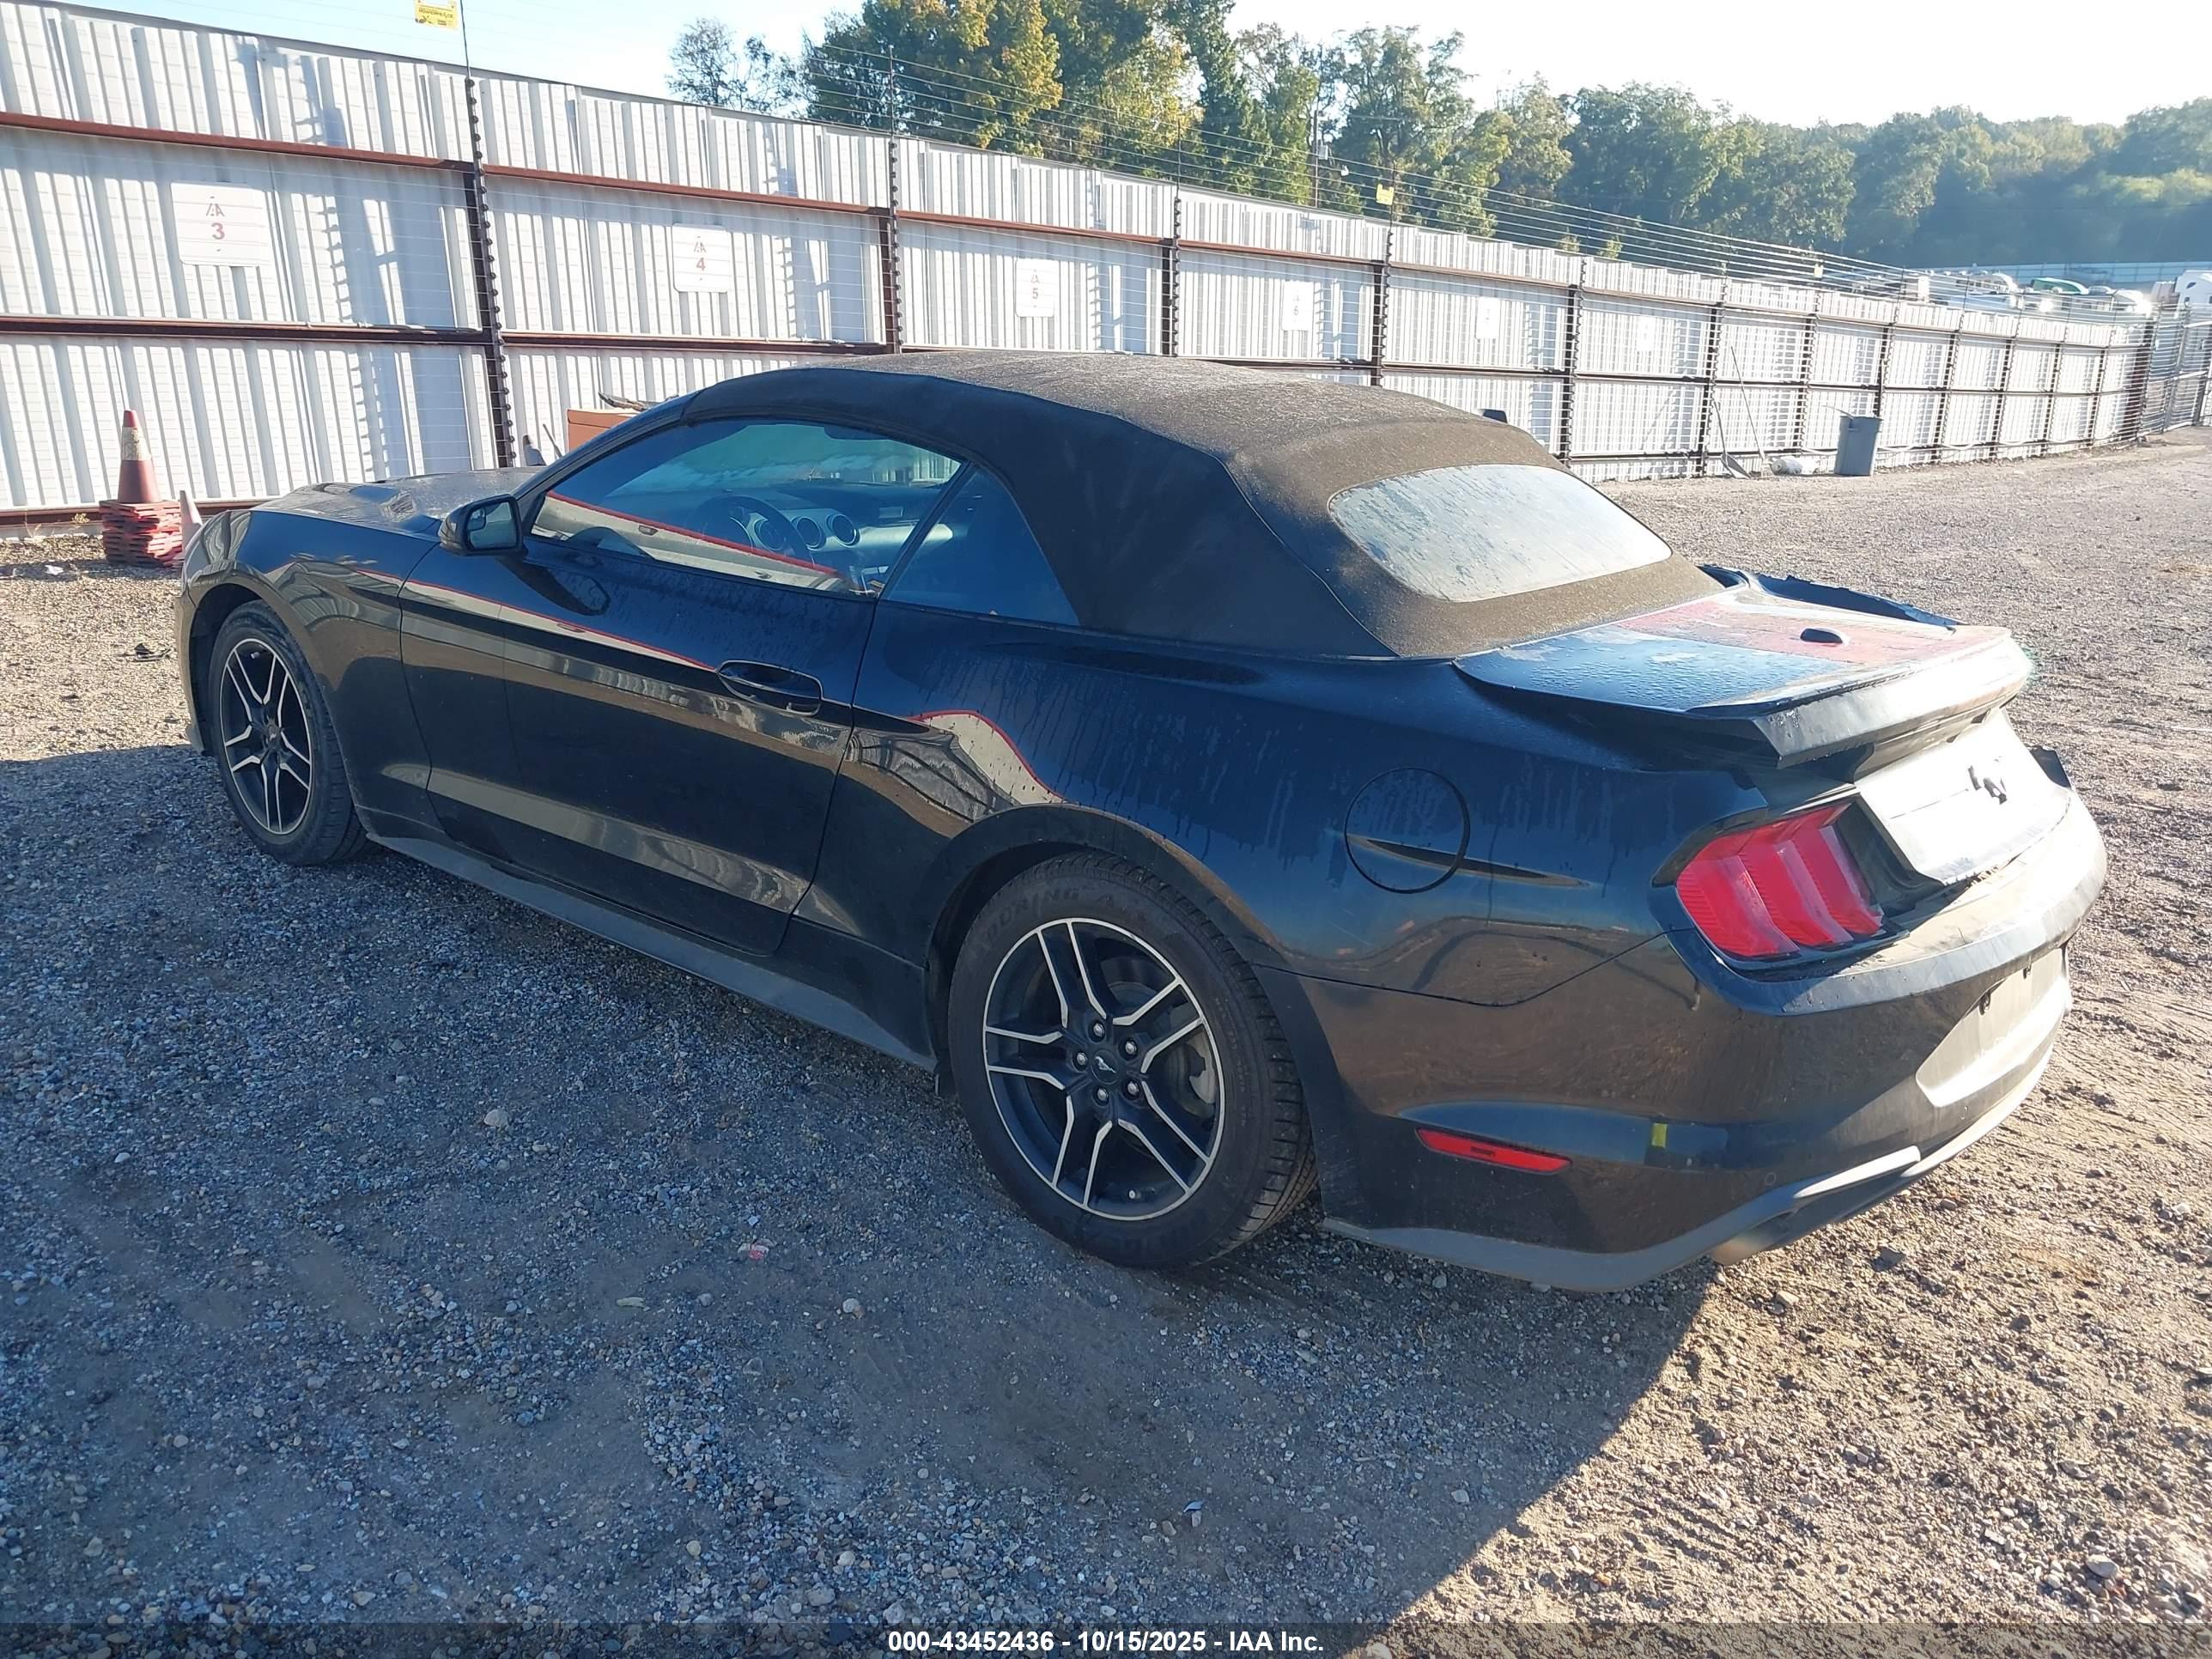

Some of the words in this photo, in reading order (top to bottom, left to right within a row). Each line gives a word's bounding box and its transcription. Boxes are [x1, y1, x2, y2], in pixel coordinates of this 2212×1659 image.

[211, 222, 225, 240] 3
[696, 258, 706, 271] 4
[1032, 288, 1039, 300] 5
